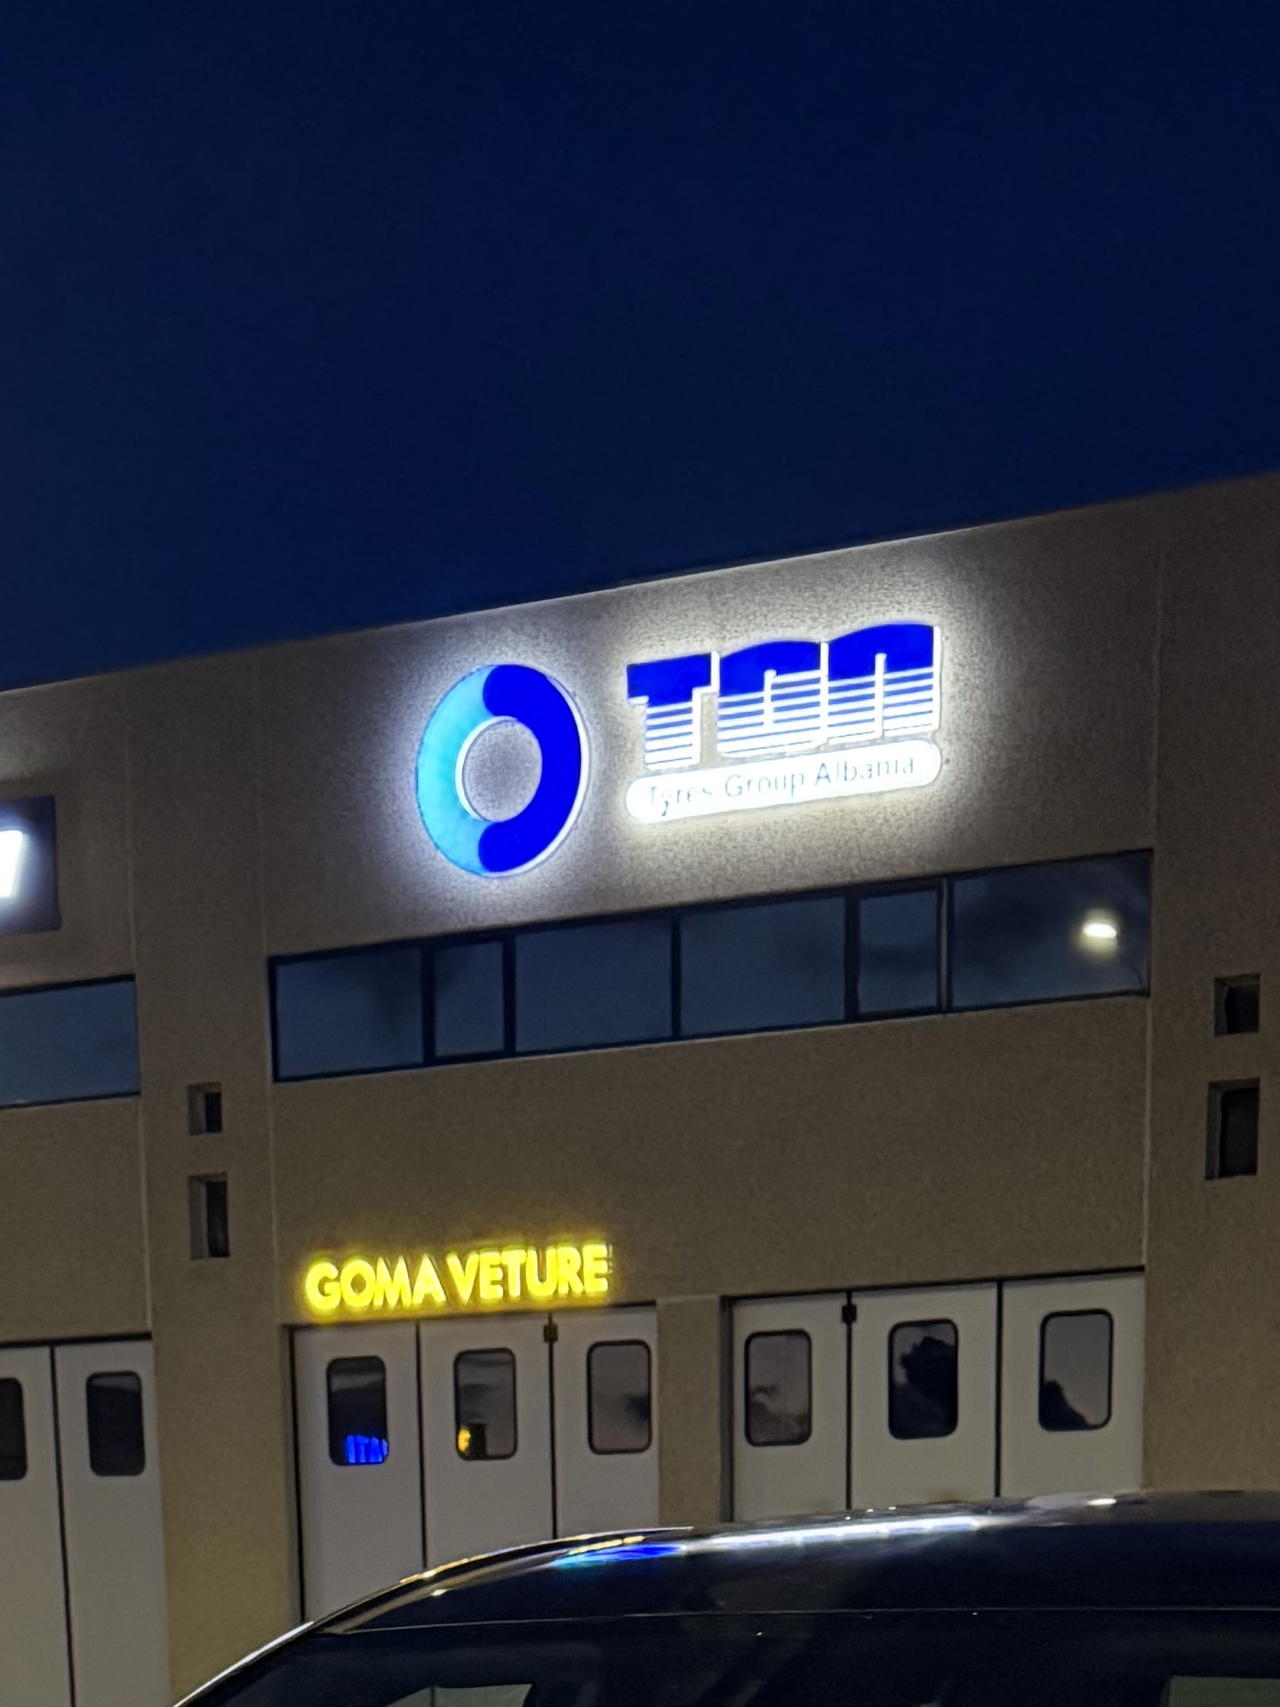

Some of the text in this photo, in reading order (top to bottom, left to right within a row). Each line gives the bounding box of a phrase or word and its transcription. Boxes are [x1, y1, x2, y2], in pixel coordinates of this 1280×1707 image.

[648, 754, 916, 817] Tyres Group Albania
[304, 1243, 612, 1312] GOMA VETURE
